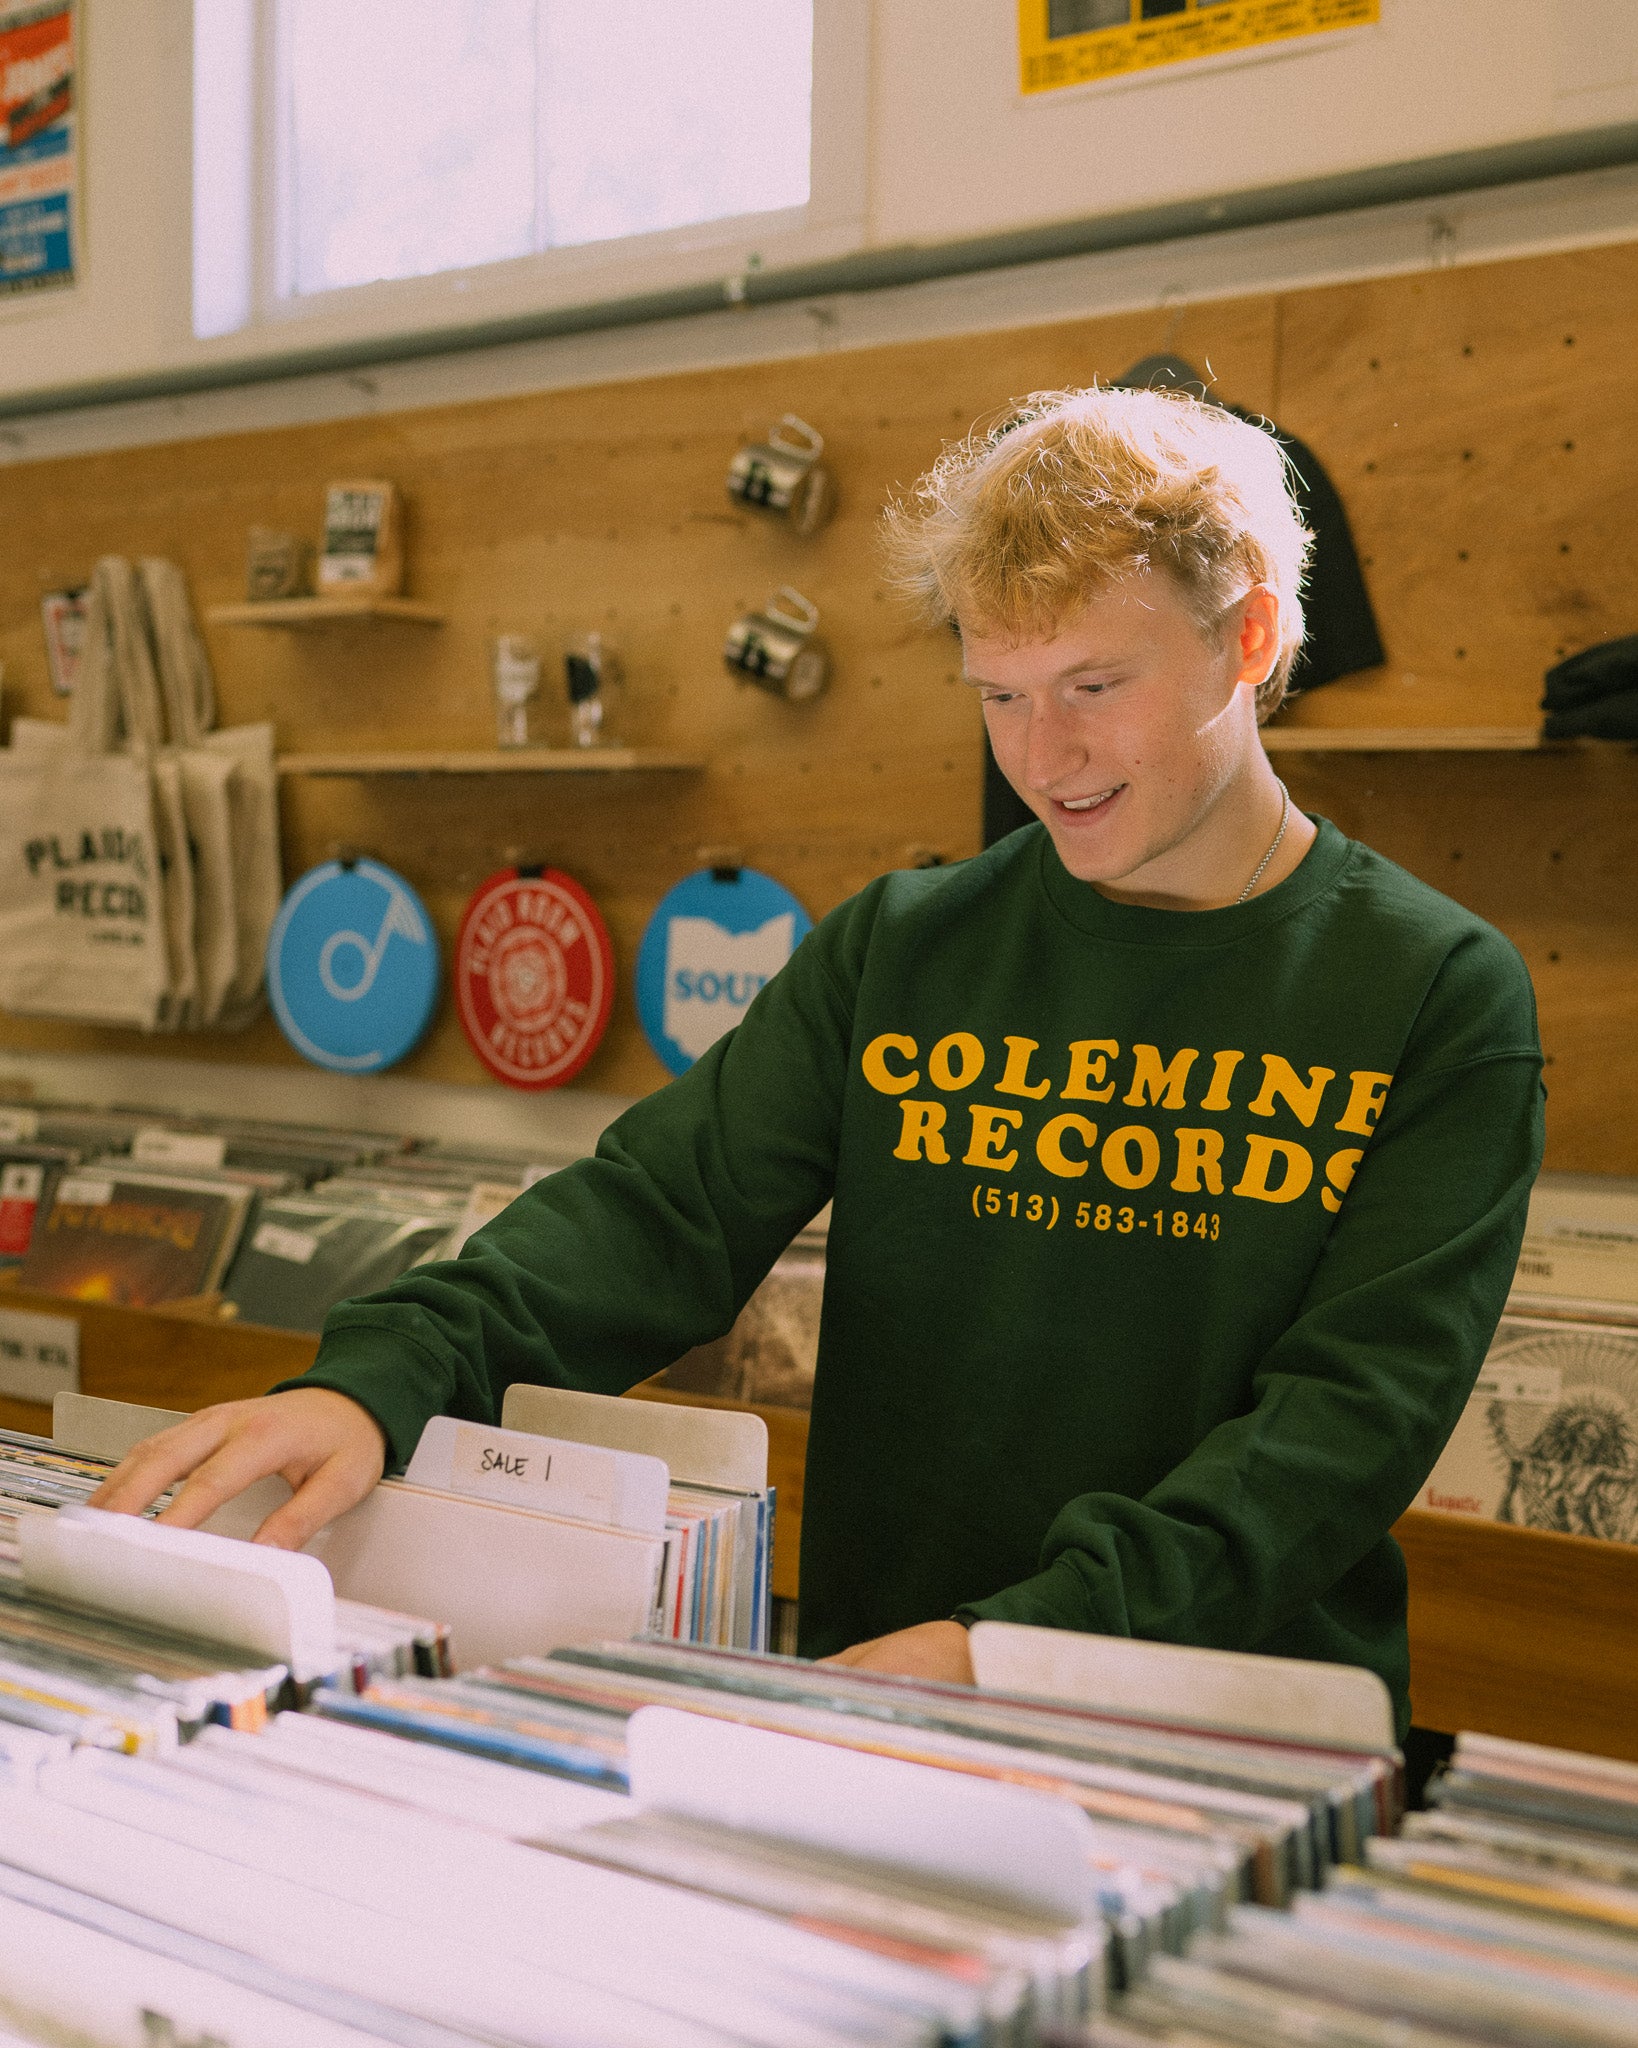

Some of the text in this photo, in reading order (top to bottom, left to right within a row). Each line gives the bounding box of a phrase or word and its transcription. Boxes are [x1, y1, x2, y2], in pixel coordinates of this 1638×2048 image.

[971, 1184, 1221, 1242] (513) 583-1843
[480, 1447, 530, 1477] SALE
